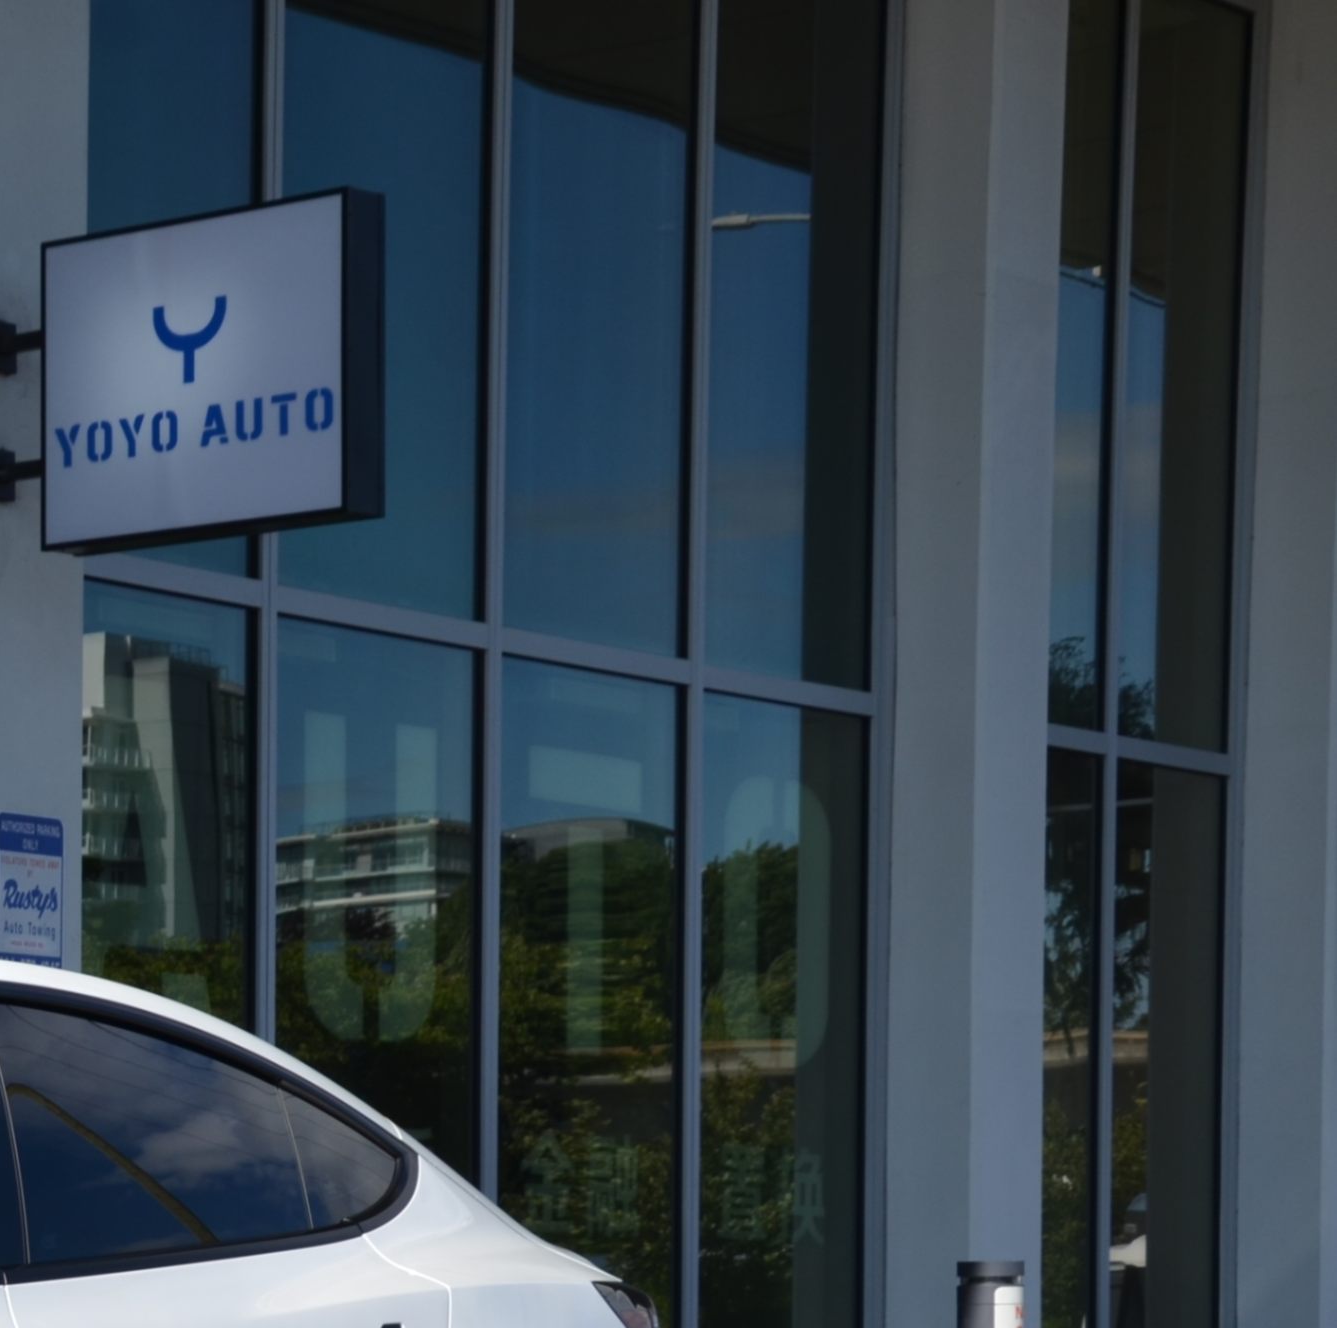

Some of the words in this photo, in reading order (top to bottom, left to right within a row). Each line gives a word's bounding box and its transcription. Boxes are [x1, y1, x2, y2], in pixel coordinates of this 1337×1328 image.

[54, 410, 179, 469] YOYO
[199, 386, 334, 448] AUTO
[36, 824, 61, 839] PARKING
[3, 878, 58, 919] Rusty's
[3, 920, 23, 935] Auto
[28, 921, 56, 942] Towing
